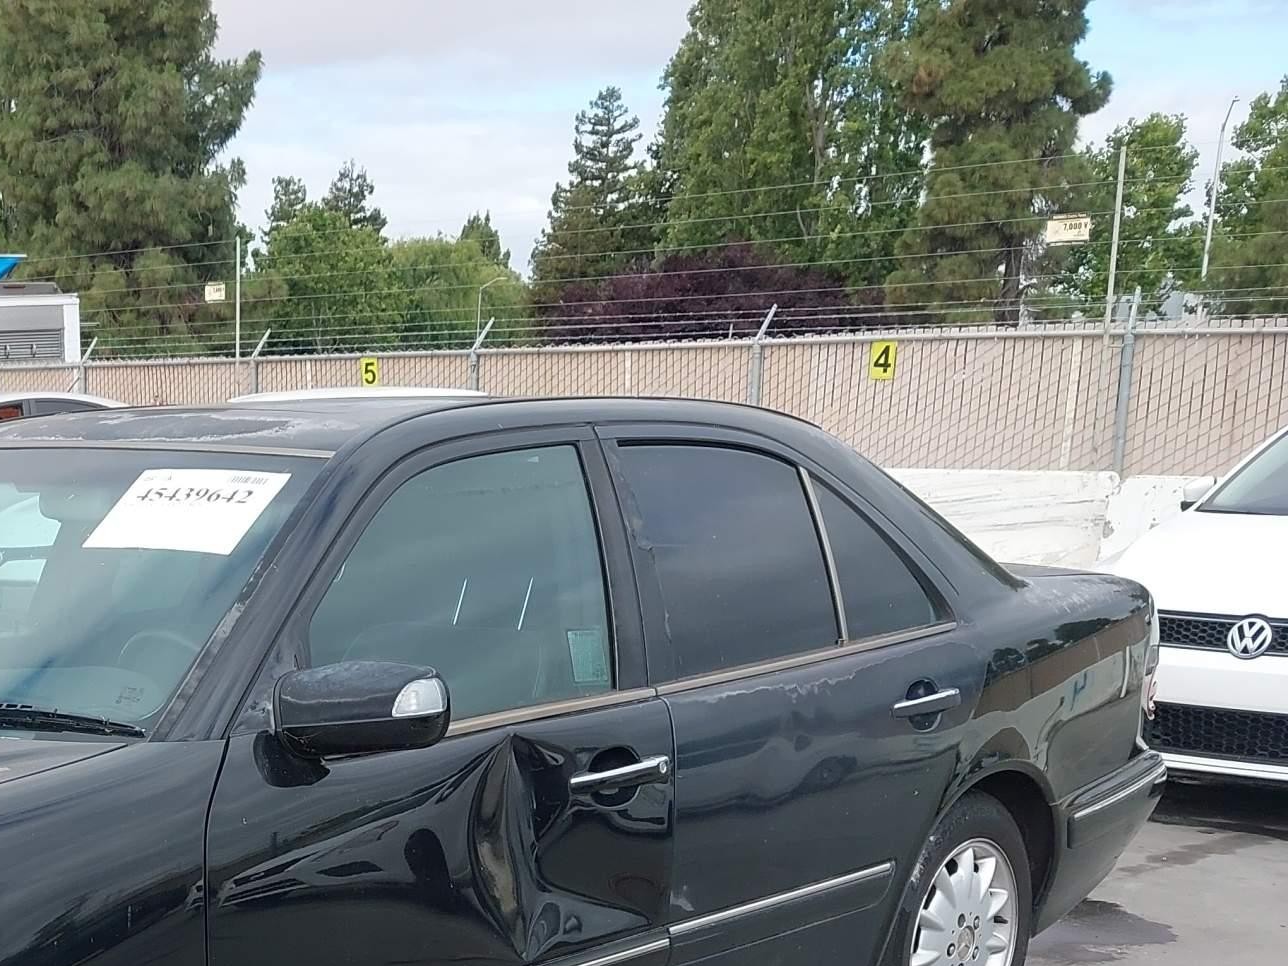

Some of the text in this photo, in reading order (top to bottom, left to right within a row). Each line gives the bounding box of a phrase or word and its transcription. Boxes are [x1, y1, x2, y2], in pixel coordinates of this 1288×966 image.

[873, 344, 892, 374] 4
[364, 362, 376, 384] 5
[136, 487, 254, 504] 45439642
